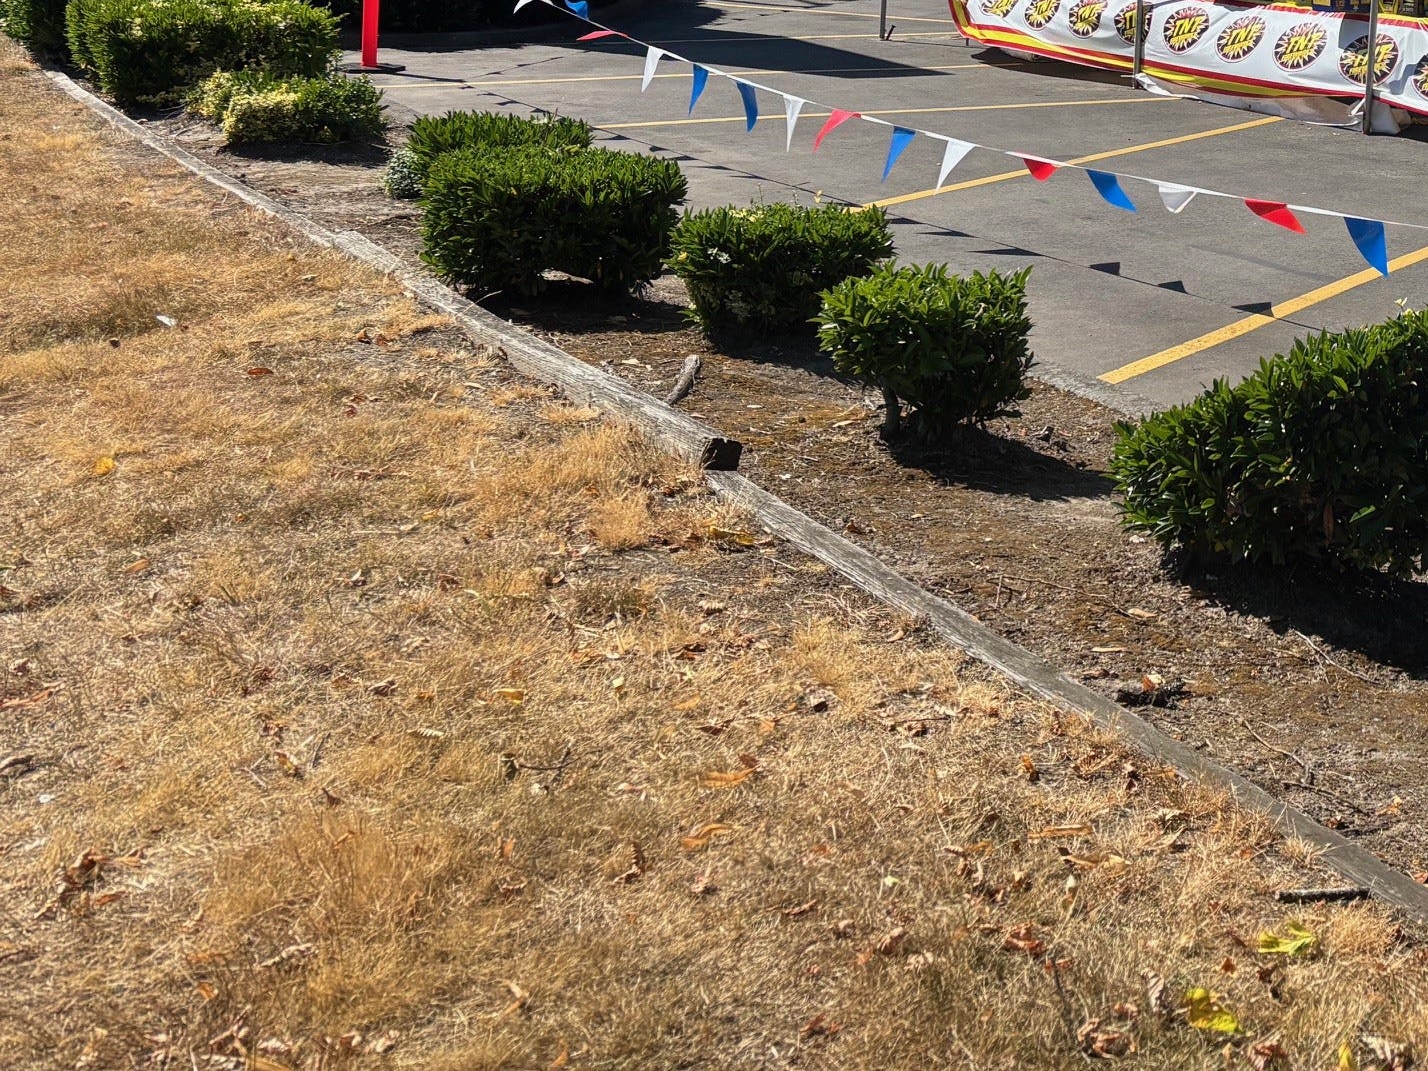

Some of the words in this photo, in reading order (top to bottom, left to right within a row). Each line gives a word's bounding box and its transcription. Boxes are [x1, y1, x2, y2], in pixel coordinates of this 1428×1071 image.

[1174, 17, 1204, 36] TNT
[1228, 24, 1262, 45] TNT
[1285, 31, 1323, 54] TNT
